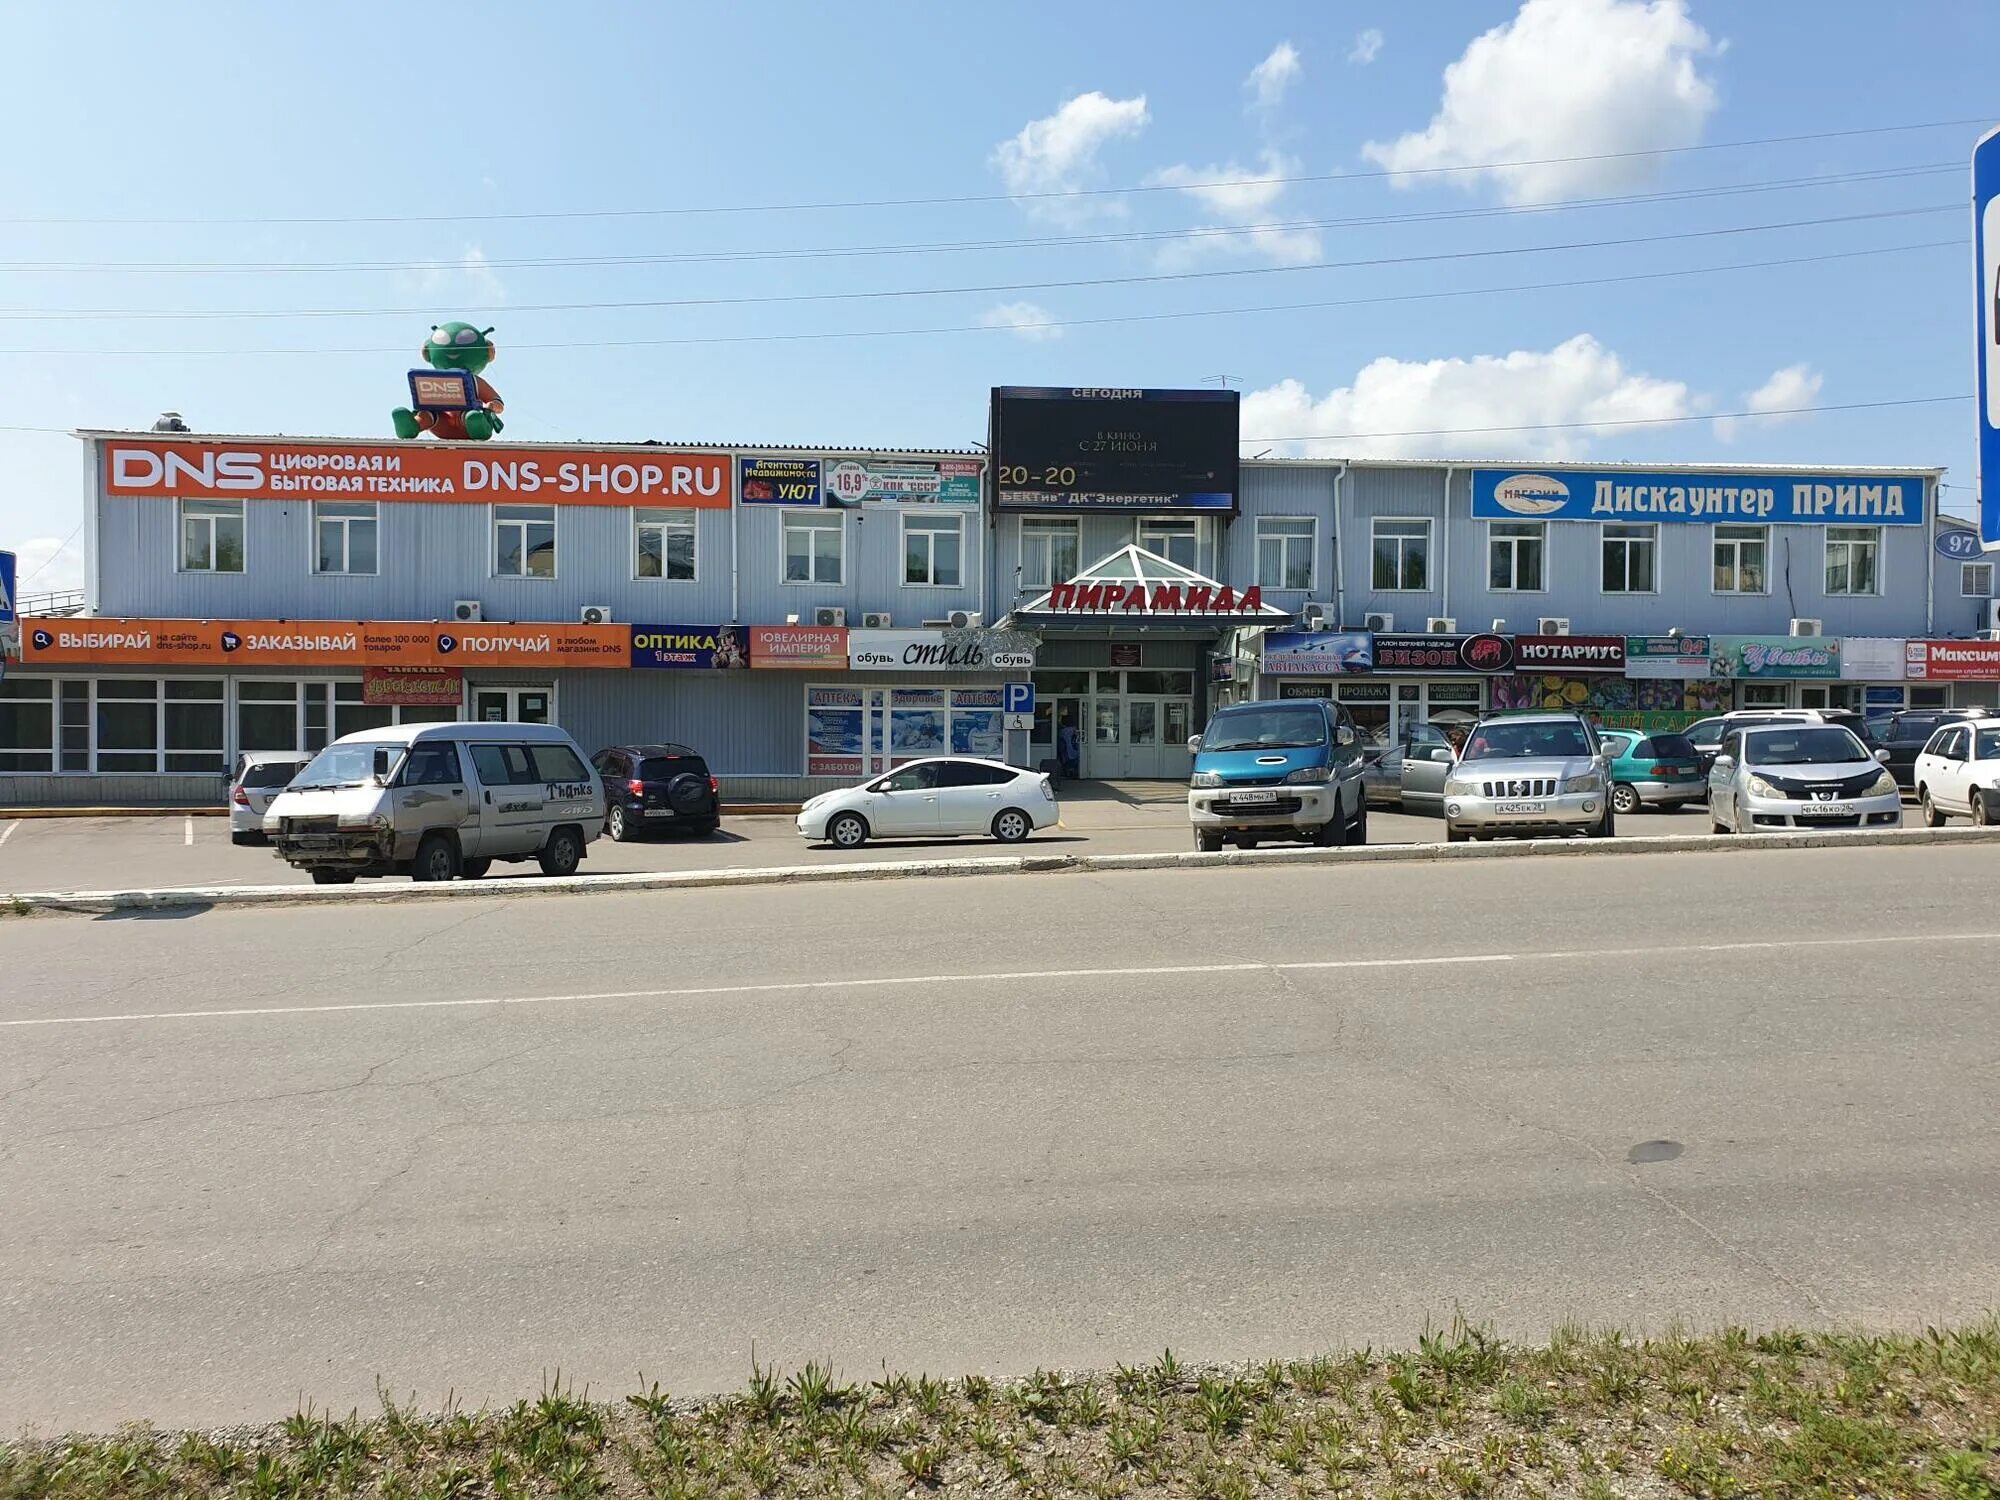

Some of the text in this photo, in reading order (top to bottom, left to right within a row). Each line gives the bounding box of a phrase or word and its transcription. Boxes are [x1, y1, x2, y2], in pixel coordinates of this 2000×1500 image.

[420, 381, 461, 393] DNS
[1072, 388, 1143, 399] СЕГОДНЯ
[1107, 432, 1141, 440] КИНО
[1093, 441, 1107, 451] 27
[1111, 441, 1157, 452] ИЮНЯ
[113, 449, 265, 489] DNS
[270, 453, 400, 472] ЦИФРОВАЯ И
[756, 459, 804, 469] Агентство
[463, 460, 720, 496] DNS-SHOP.RU
[745, 467, 817, 478] Недвижимости
[1000, 466, 1076, 486] 20-20
[270, 475, 455, 493] БЫТОВАЯ ТЕХНИКА
[883, 481, 904, 491] КПК
[778, 484, 818, 500] УЮТ
[1592, 480, 1905, 517] Дискаунтер ПРИМА
[1950, 535, 1975, 553] 97
[1048, 583, 1262, 611] ПИРАМИДА
[59, 630, 150, 649] ВЫБИРАЙ
[171, 634, 198, 642] сайте
[247, 633, 357, 650] ЗАКАЗЫВАЙ
[363, 634, 430, 644] более 100 000
[462, 634, 550, 652] ПОЛУЧАЙ
[565, 637, 597, 646] любом
[634, 635, 717, 650] ОПТИКА
[760, 633, 839, 643] ЮВЕЛИРНАЯ
[156, 641, 212, 651] dns-shop.ru
[363, 644, 402, 652] товаров
[557, 645, 622, 654] магазине DNS
[769, 643, 831, 653] ИМПЕРИЯ
[1521, 644, 1622, 659] НОТАРИУС
[655, 650, 696, 663] 1 этаж
[857, 652, 894, 663] обувь
[995, 654, 1031, 666] обувь
[1379, 650, 1457, 665] БИЗОН
[1741, 644, 1829, 673] Цветы
[1931, 646, 2000, 661] Максим
[1268, 662, 1342, 672] АВИАКАССА
[815, 692, 858, 703] АПТЕКА
[955, 693, 1000, 704] АПТЕКА
[1287, 687, 1325, 697] ОБМЕН
[1339, 687, 1389, 697] ПРОДАЖА
[546, 783, 592, 800] Thanks
